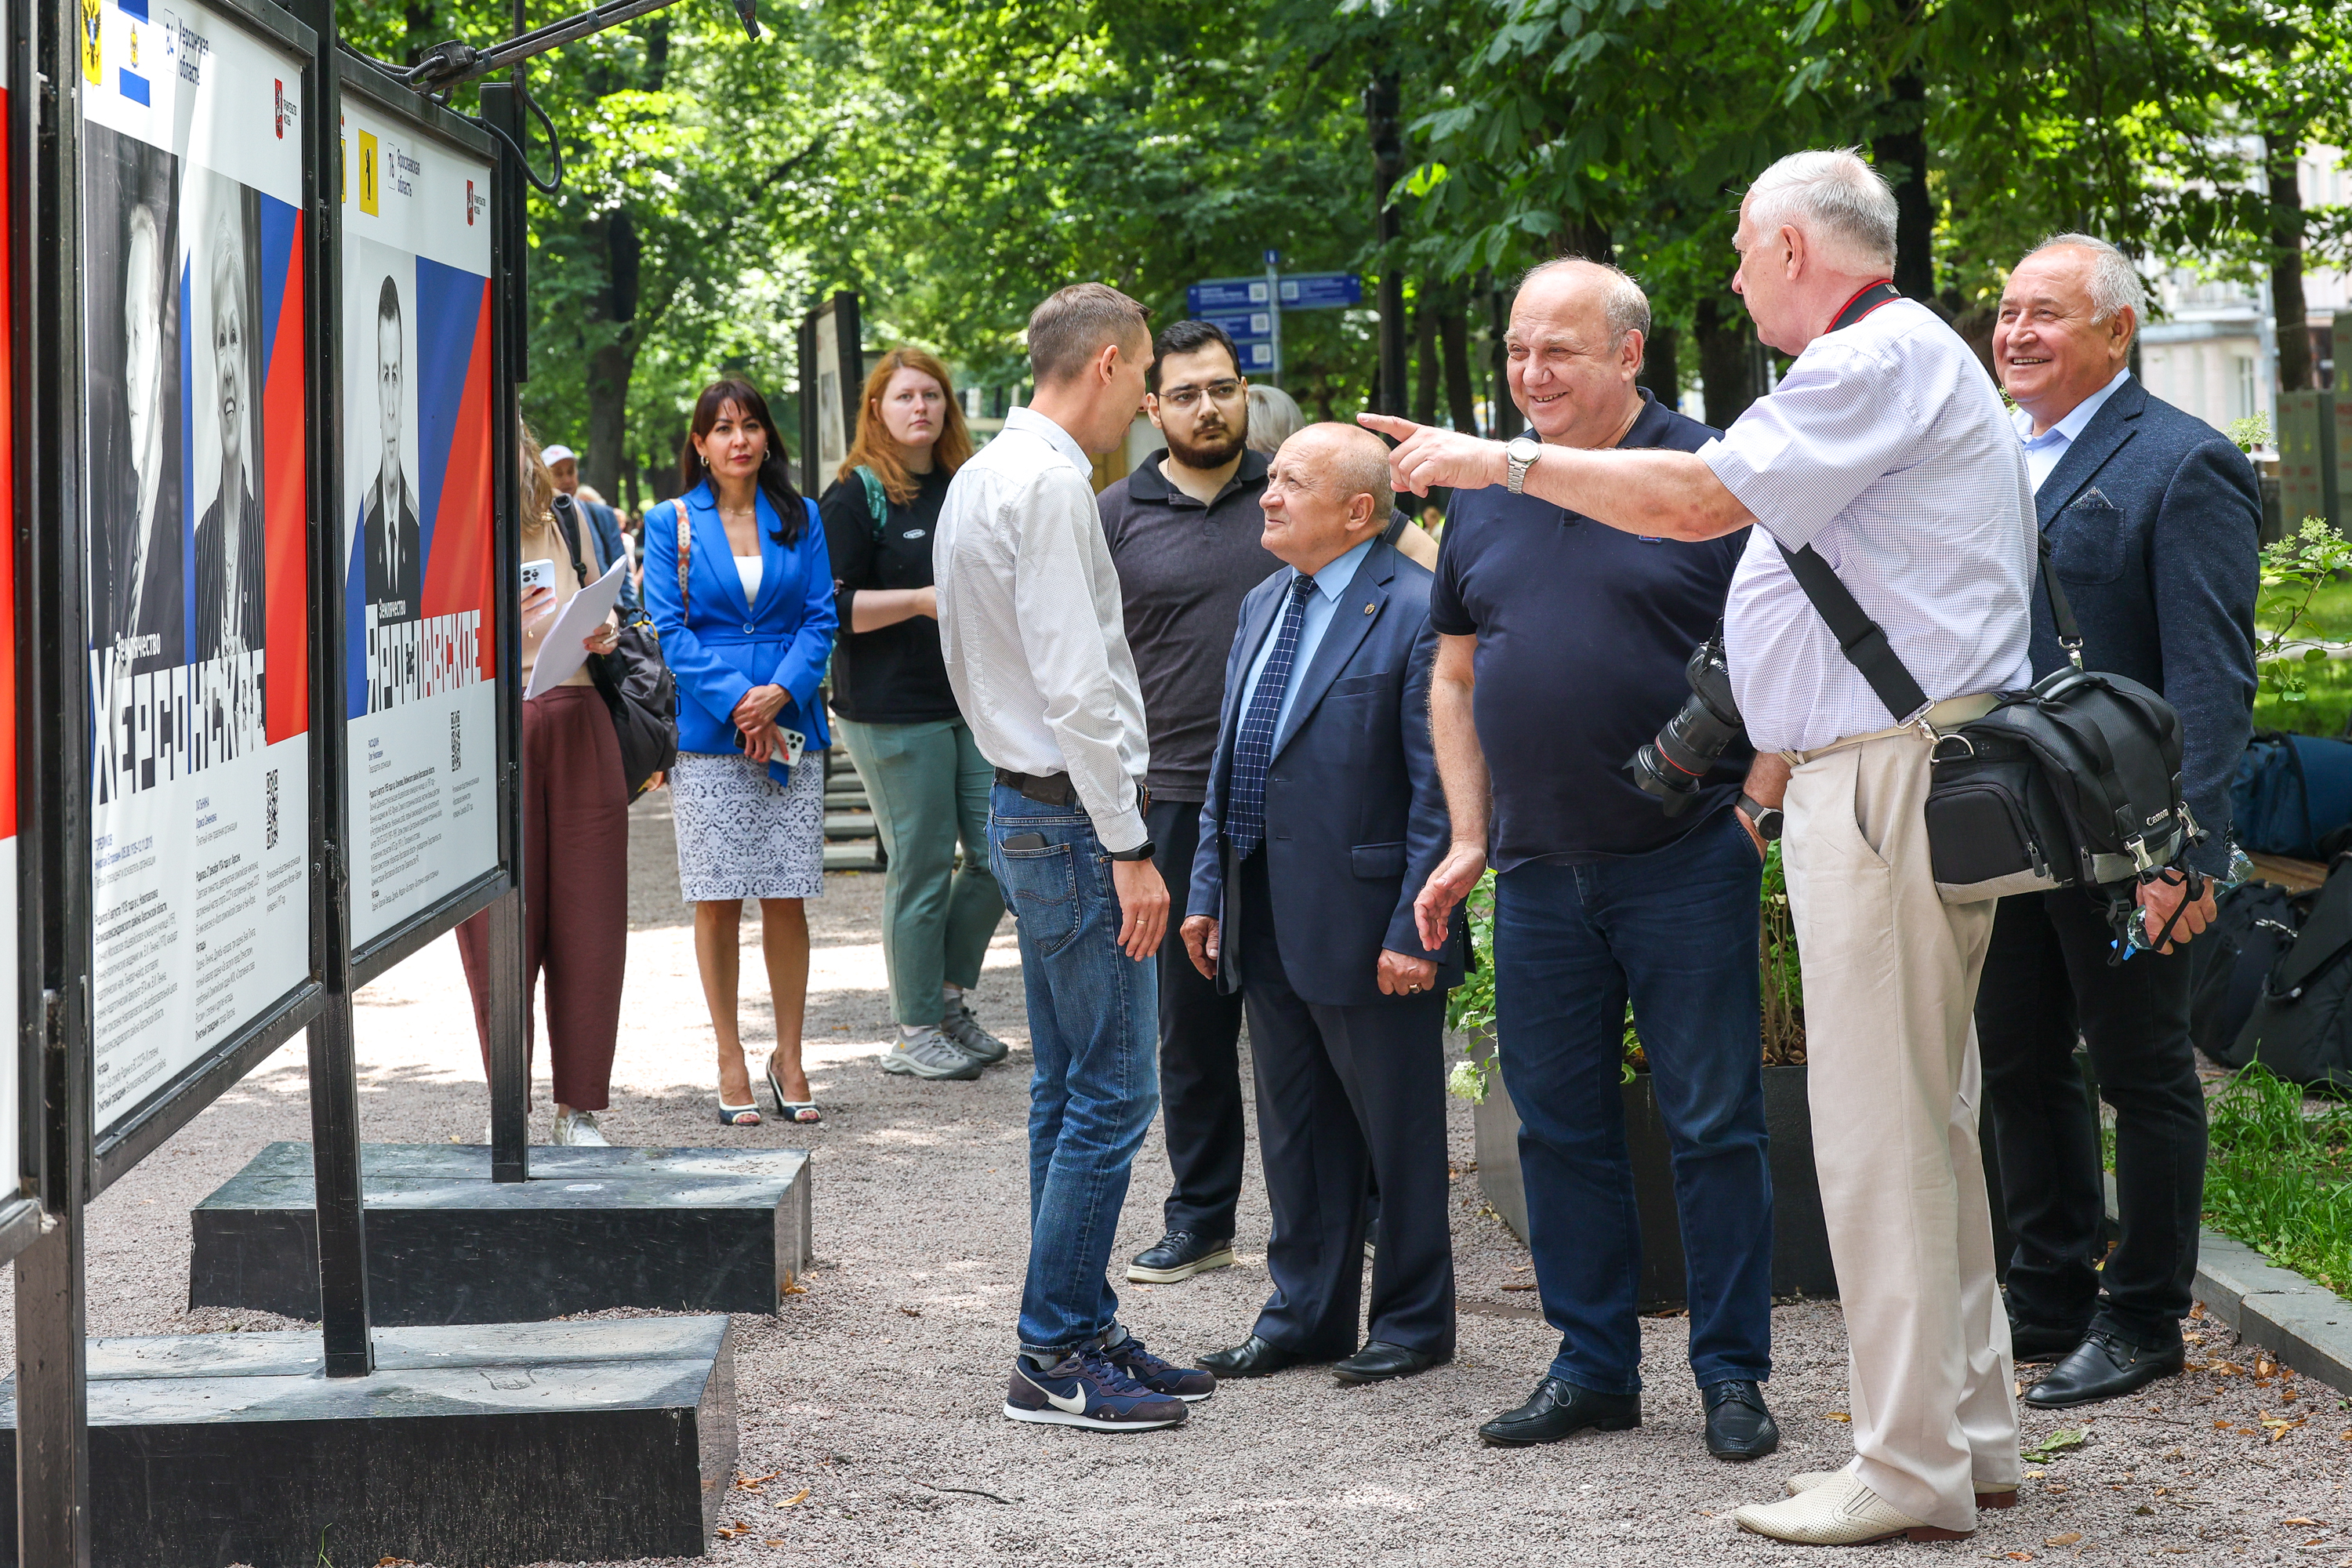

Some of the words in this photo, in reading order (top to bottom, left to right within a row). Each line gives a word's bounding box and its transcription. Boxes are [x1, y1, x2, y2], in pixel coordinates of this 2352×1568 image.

[165, 23, 174, 56] 84
[178, 16, 209, 57] Херсонская
[179, 54, 200, 86] область
[388, 152, 395, 179] 76
[397, 148, 420, 176] Ярославская
[397, 175, 412, 198] область
[379, 598, 407, 619] Землячество
[115, 631, 162, 662] Землячество
[365, 604, 481, 715] ЯРОСЛАВСКОЕ
[89, 647, 266, 808] ХЕРСОНСКОЕ
[2146, 808, 2169, 826] Canon
